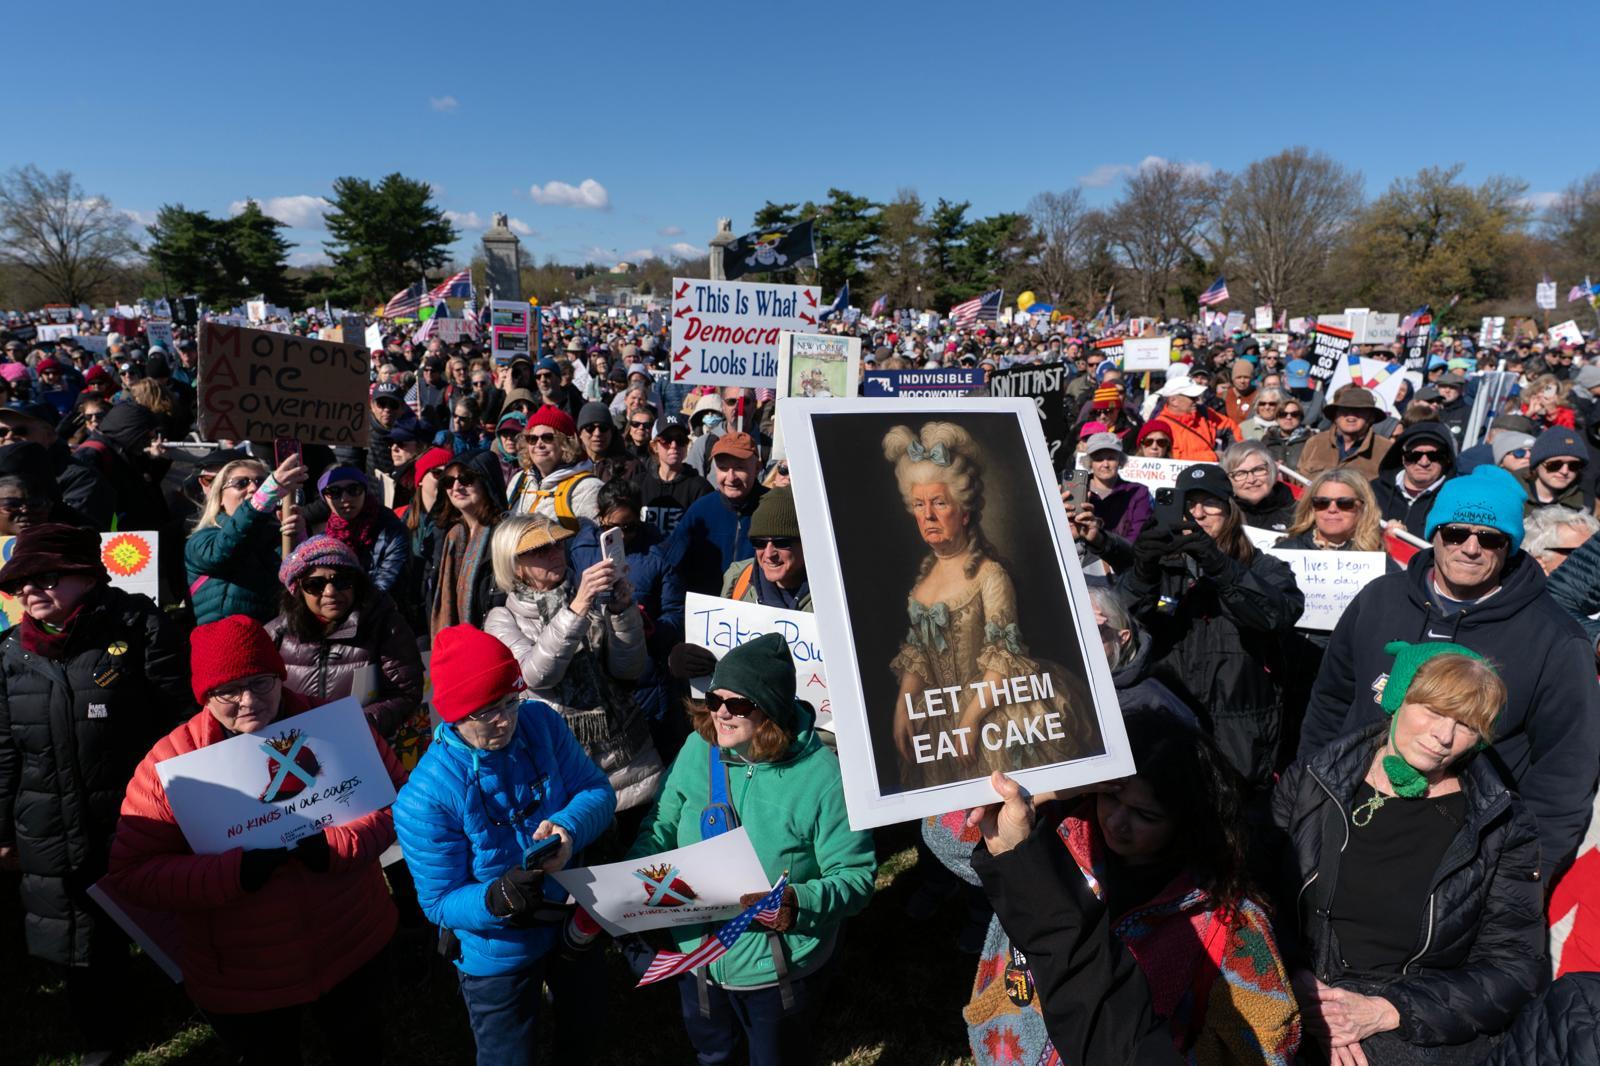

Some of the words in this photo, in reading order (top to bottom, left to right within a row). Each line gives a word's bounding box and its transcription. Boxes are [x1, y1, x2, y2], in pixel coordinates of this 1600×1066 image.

[695, 285, 730, 313] This
[735, 288, 749, 315] Is
[755, 289, 798, 318] What
[683, 316, 780, 346] Democra
[1315, 332, 1350, 350] TRUMP
[700, 348, 746, 375] Looks
[1314, 345, 1343, 360] MUST
[1409, 347, 1421, 358] GO
[1318, 356, 1333, 369] GO
[898, 373, 973, 385] INDIVISIBLE
[1032, 367, 1064, 394] PAST
[1142, 462, 1162, 470] AND
[1304, 556, 1328, 572] lives
[1337, 557, 1370, 574] begin
[1305, 575, 1326, 585] the
[904, 685, 962, 720] LET
[969, 672, 1055, 709] THEM
[912, 727, 971, 764] EAT
[980, 712, 1066, 751] CAKE
[227, 824, 243, 838] NO
[246, 808, 281, 830] KINGS
[284, 802, 296, 815] IN
[300, 793, 321, 809] OUR
